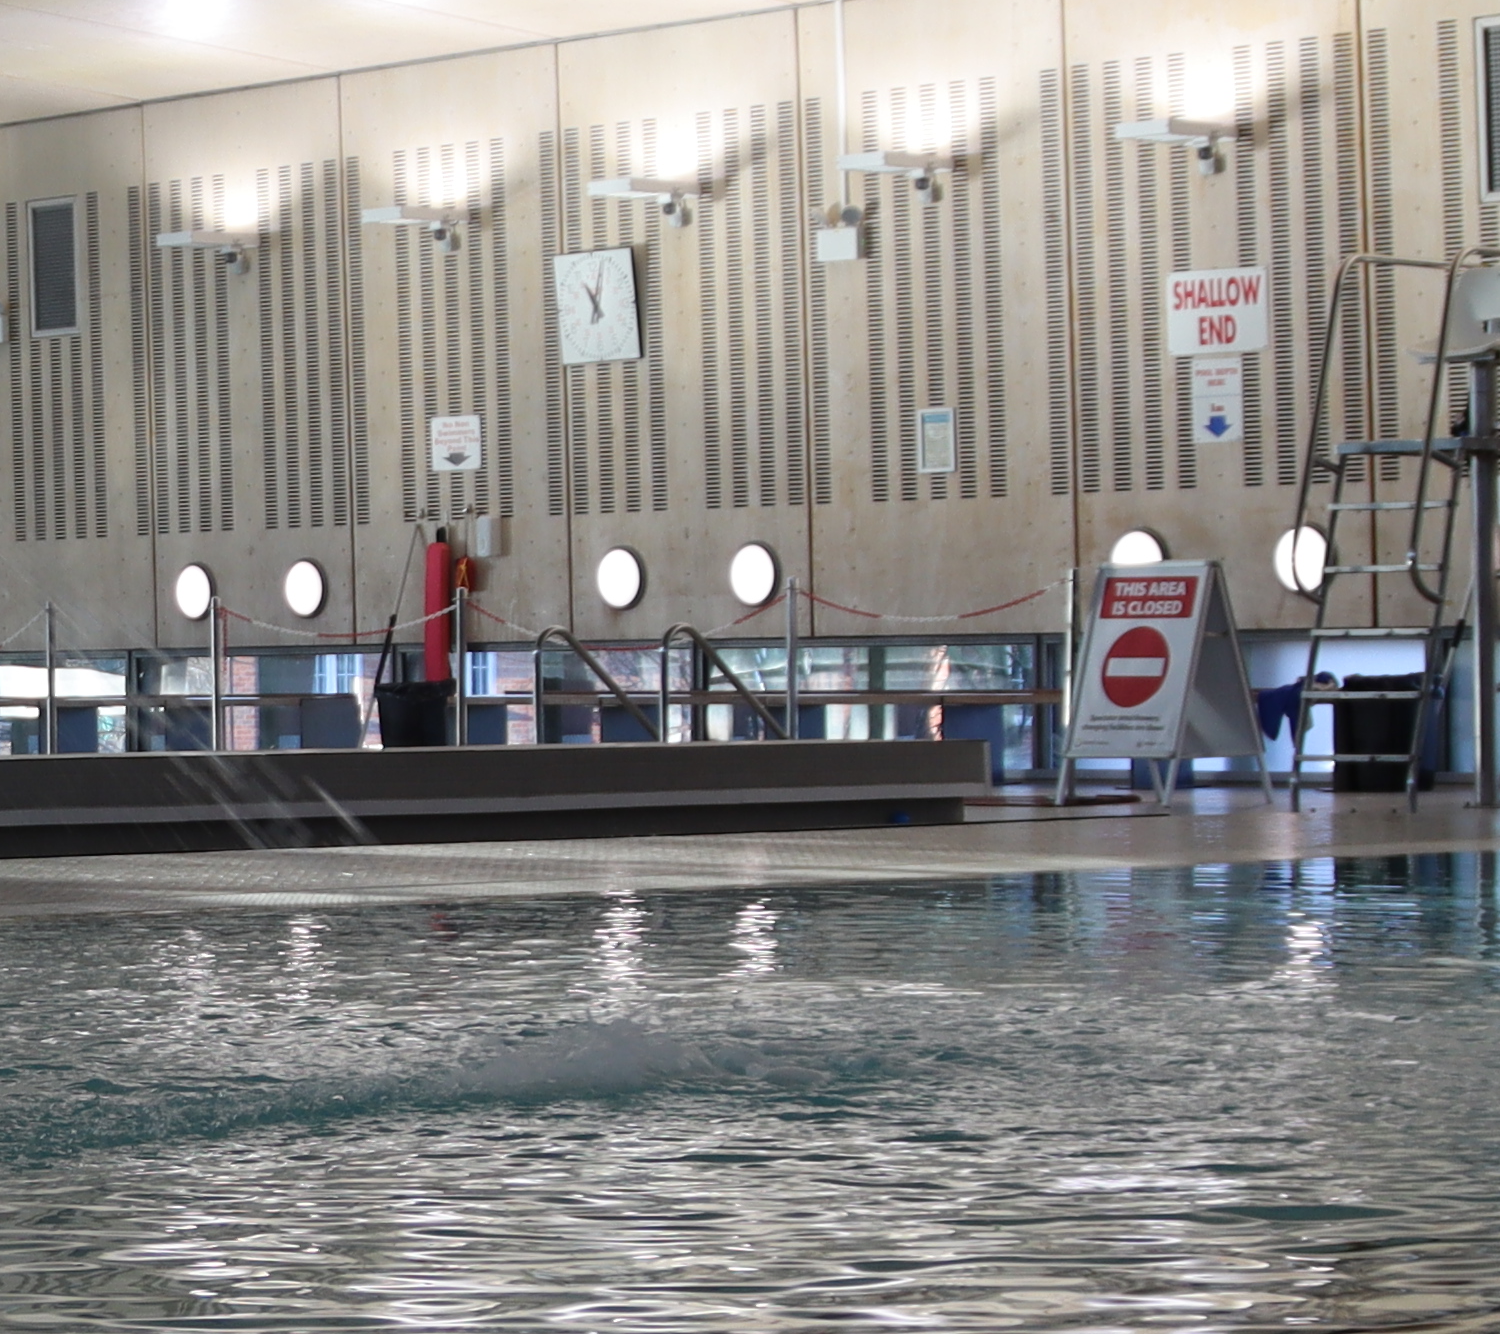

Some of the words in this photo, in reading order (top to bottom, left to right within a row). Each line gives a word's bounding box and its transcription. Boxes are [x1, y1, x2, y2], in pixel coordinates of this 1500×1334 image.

[1173, 275, 1261, 311] SHALLOW
[1198, 315, 1237, 345] END
[1115, 581, 1147, 596] THIS
[1148, 580, 1187, 596] AREA
[1111, 600, 1127, 616] IS
[1127, 599, 1183, 616] CLOSED
